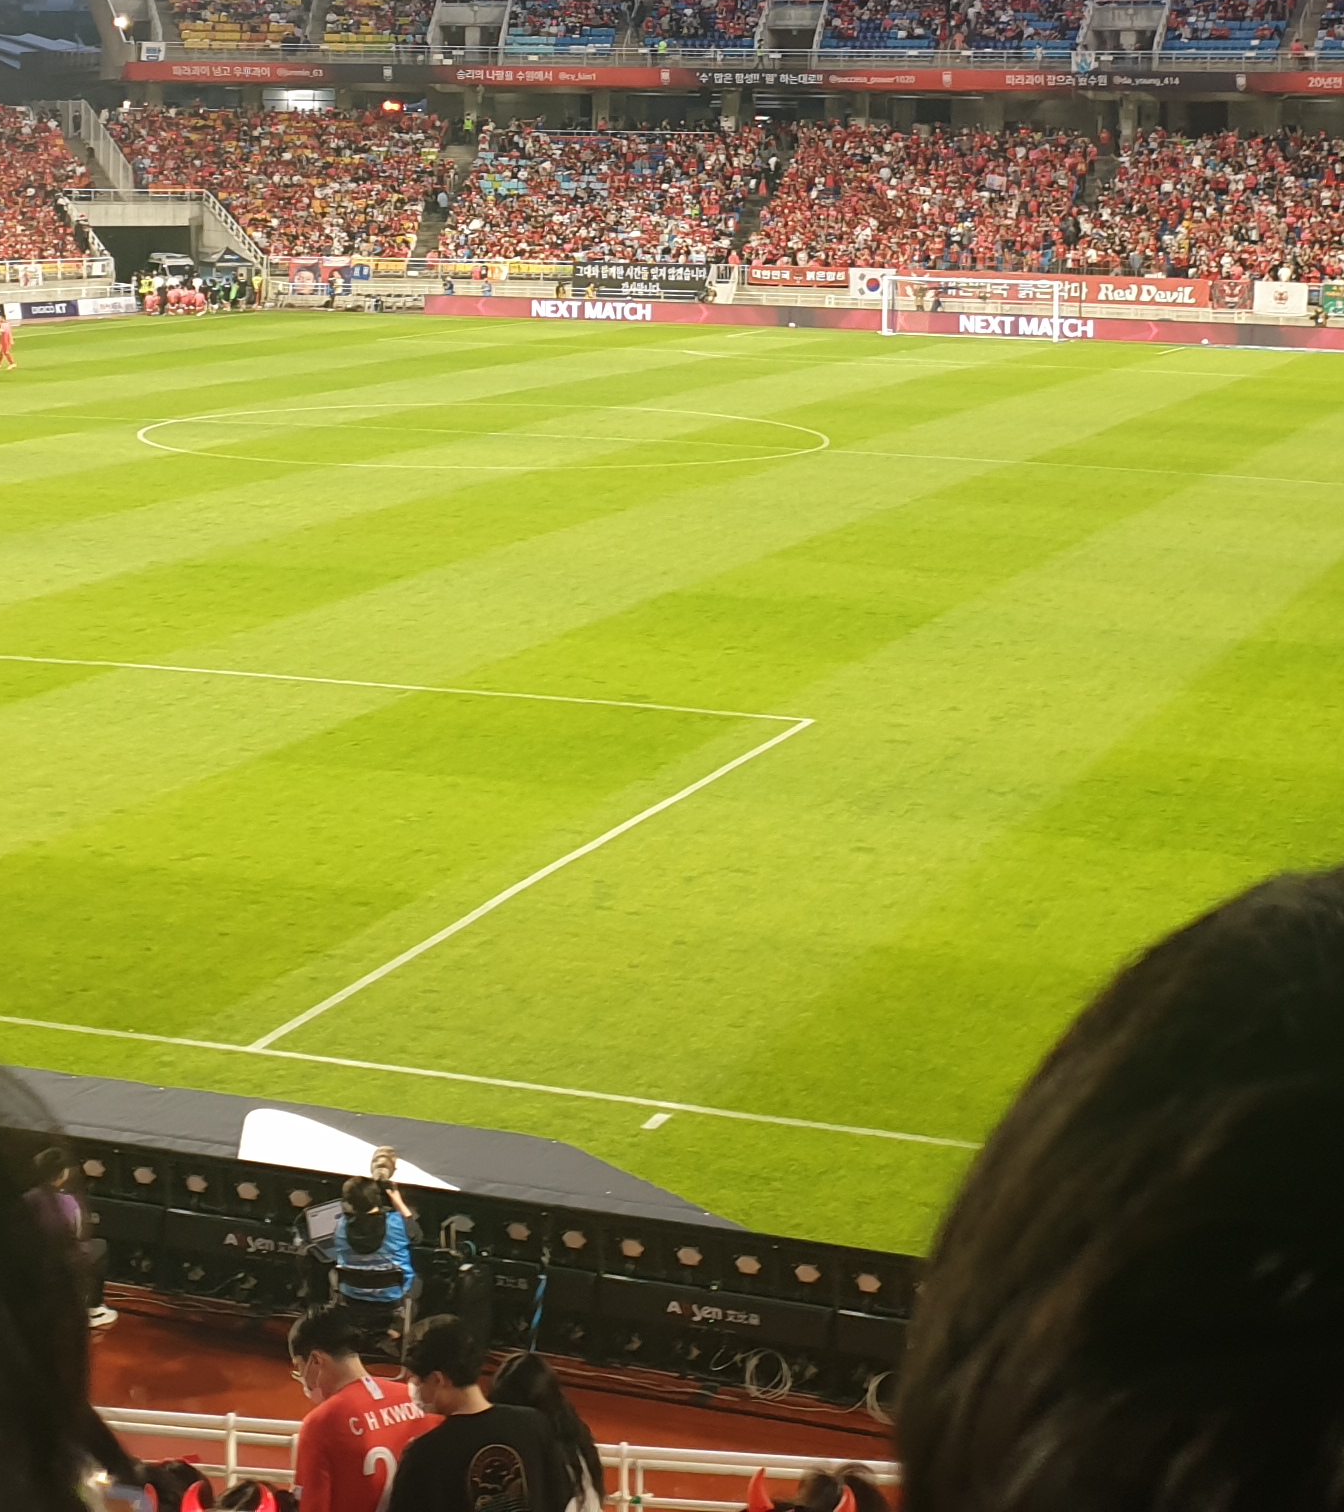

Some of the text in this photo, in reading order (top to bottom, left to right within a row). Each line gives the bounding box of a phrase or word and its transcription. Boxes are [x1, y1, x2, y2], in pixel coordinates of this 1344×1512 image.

[456, 69, 484, 80] 승리의
[516, 70, 553, 82] 수원에서
[1006, 74, 1044, 86] 파라과이
[575, 265, 600, 279] 그대와
[625, 266, 649, 280] 시간들
[650, 267, 666, 281] 잊지
[751, 268, 791, 281] 대한민국
[1098, 283, 1137, 302] Red
[531, 300, 652, 320] NEXT MATCH
[959, 314, 1094, 338] NEXT MATCH
[348, 1401, 425, 1435] C H KWON
